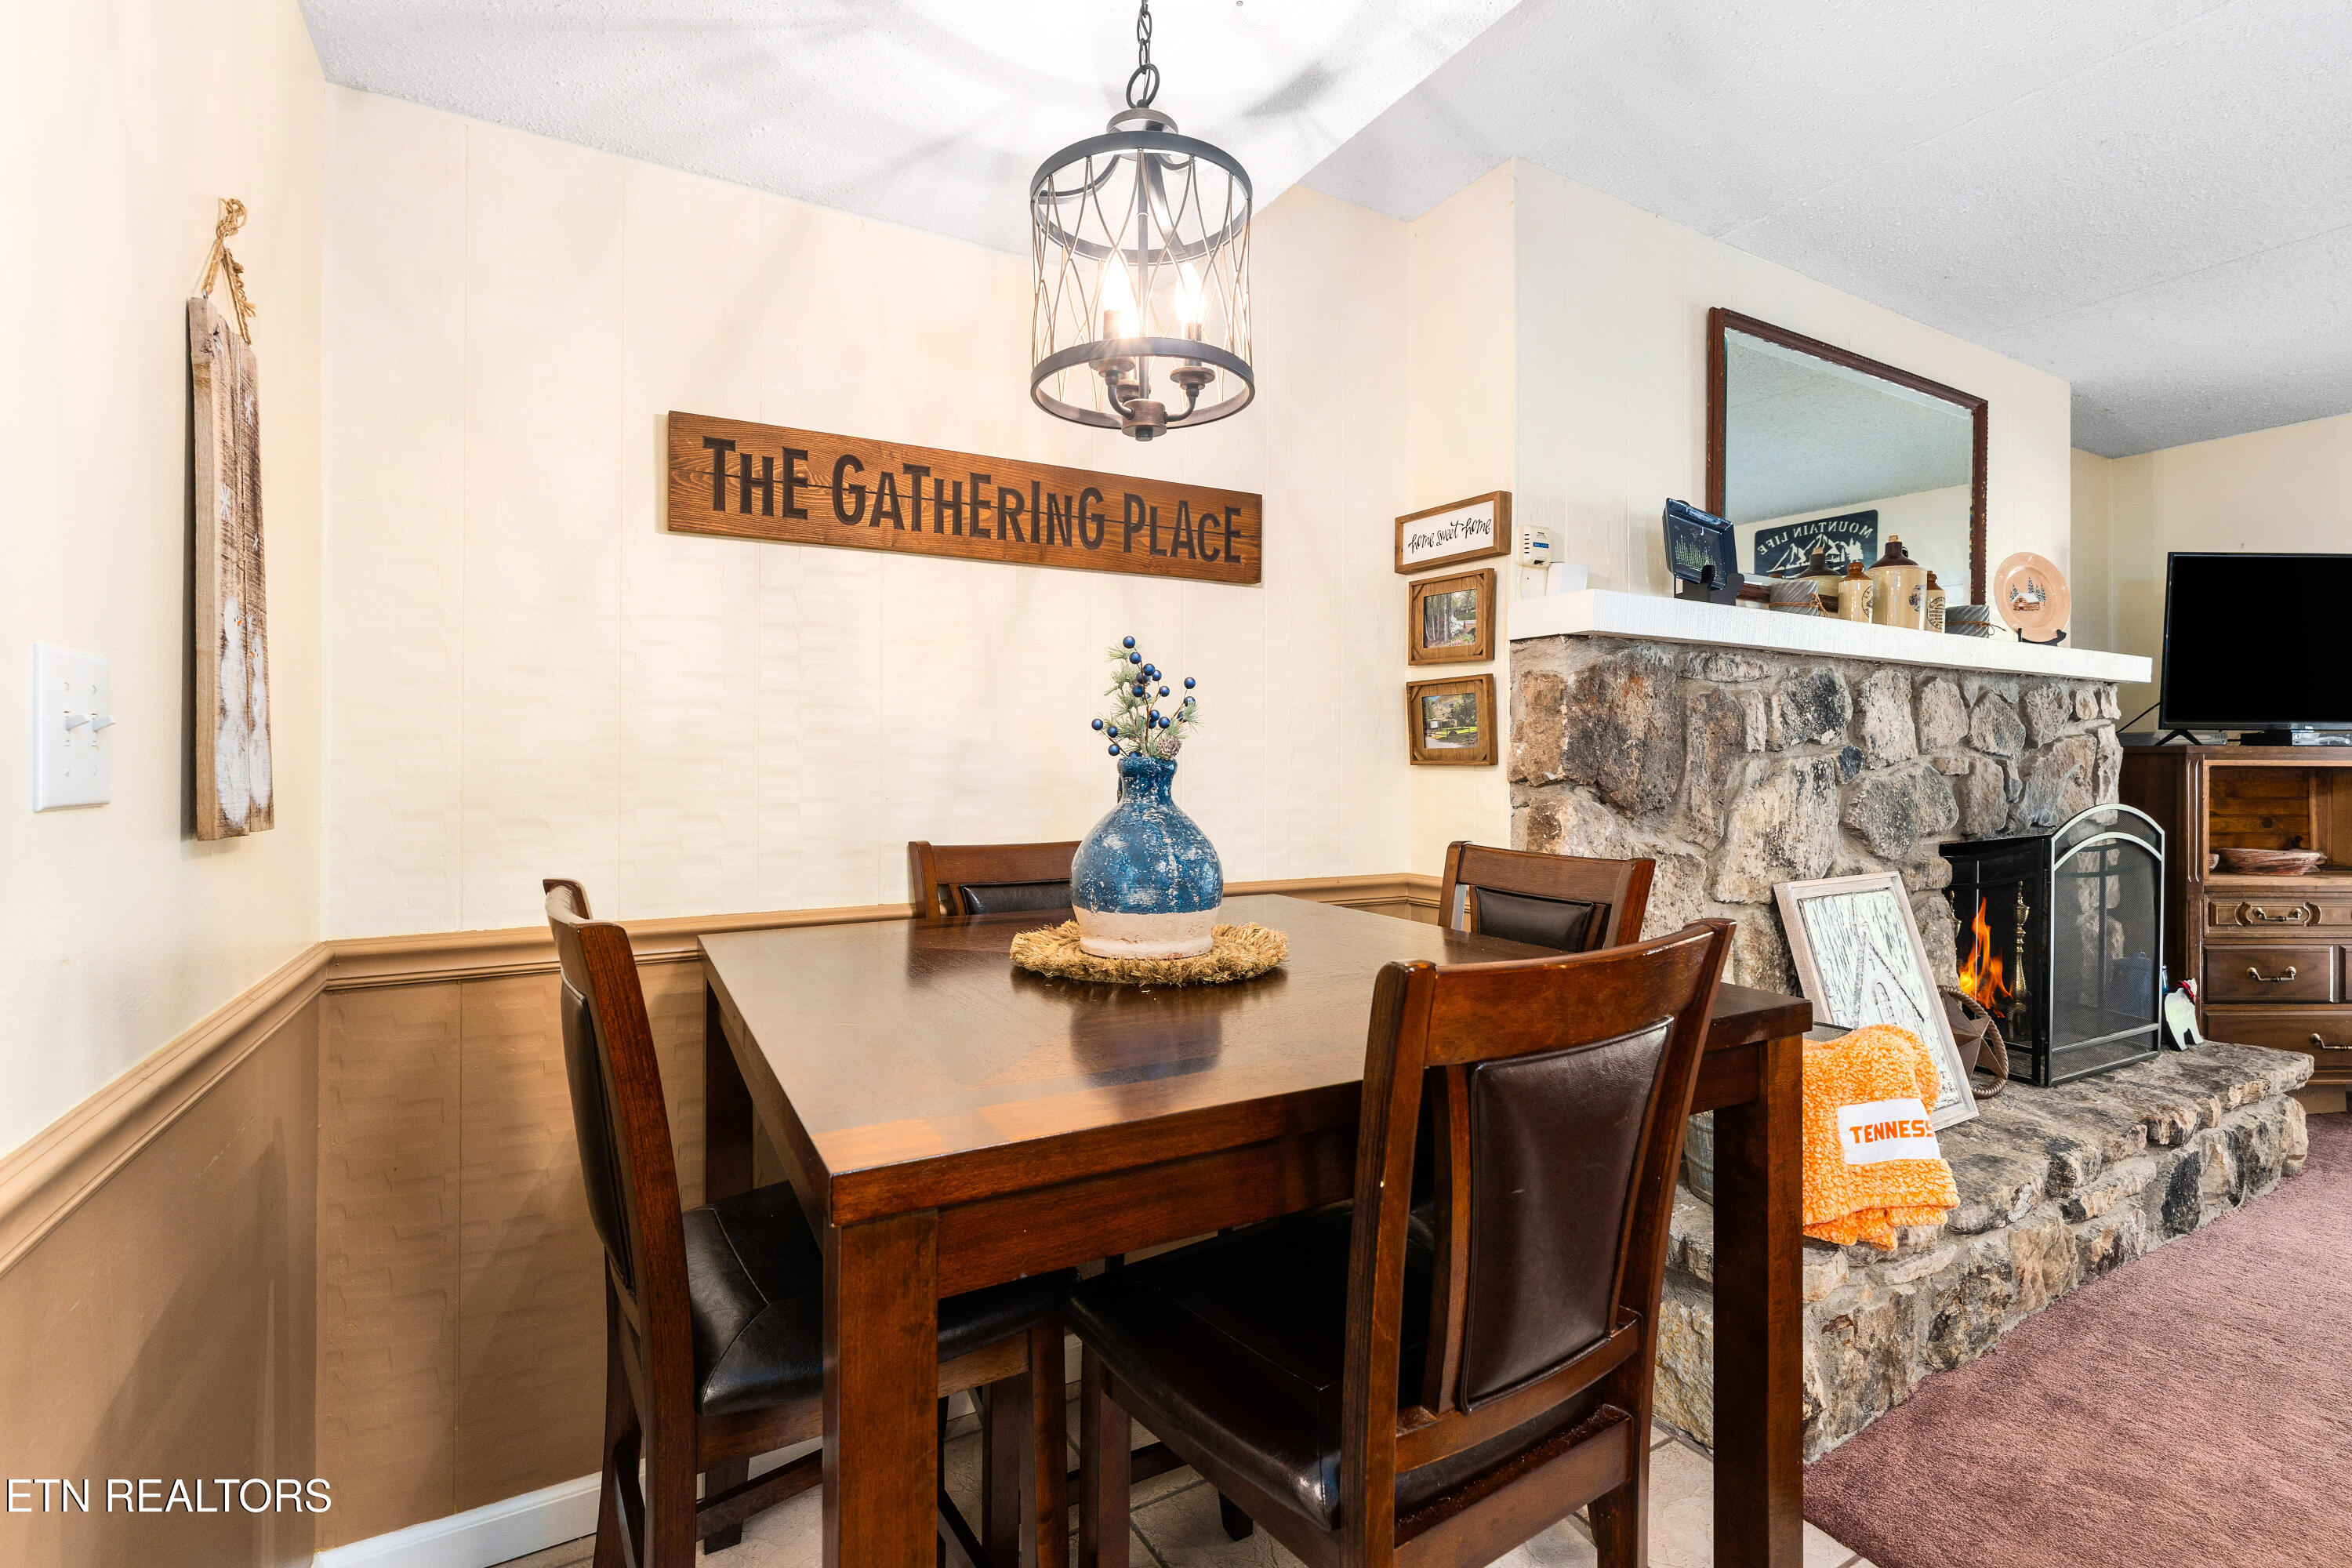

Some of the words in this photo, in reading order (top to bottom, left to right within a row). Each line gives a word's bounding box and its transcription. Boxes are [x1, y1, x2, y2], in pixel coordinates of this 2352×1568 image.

[702, 436, 808, 521] THE
[833, 454, 1105, 550] GATHERING
[1123, 492, 1242, 564] PLACE
[1408, 533, 1435, 554] home
[1436, 520, 1464, 546] sweet
[1461, 517, 1492, 539] home
